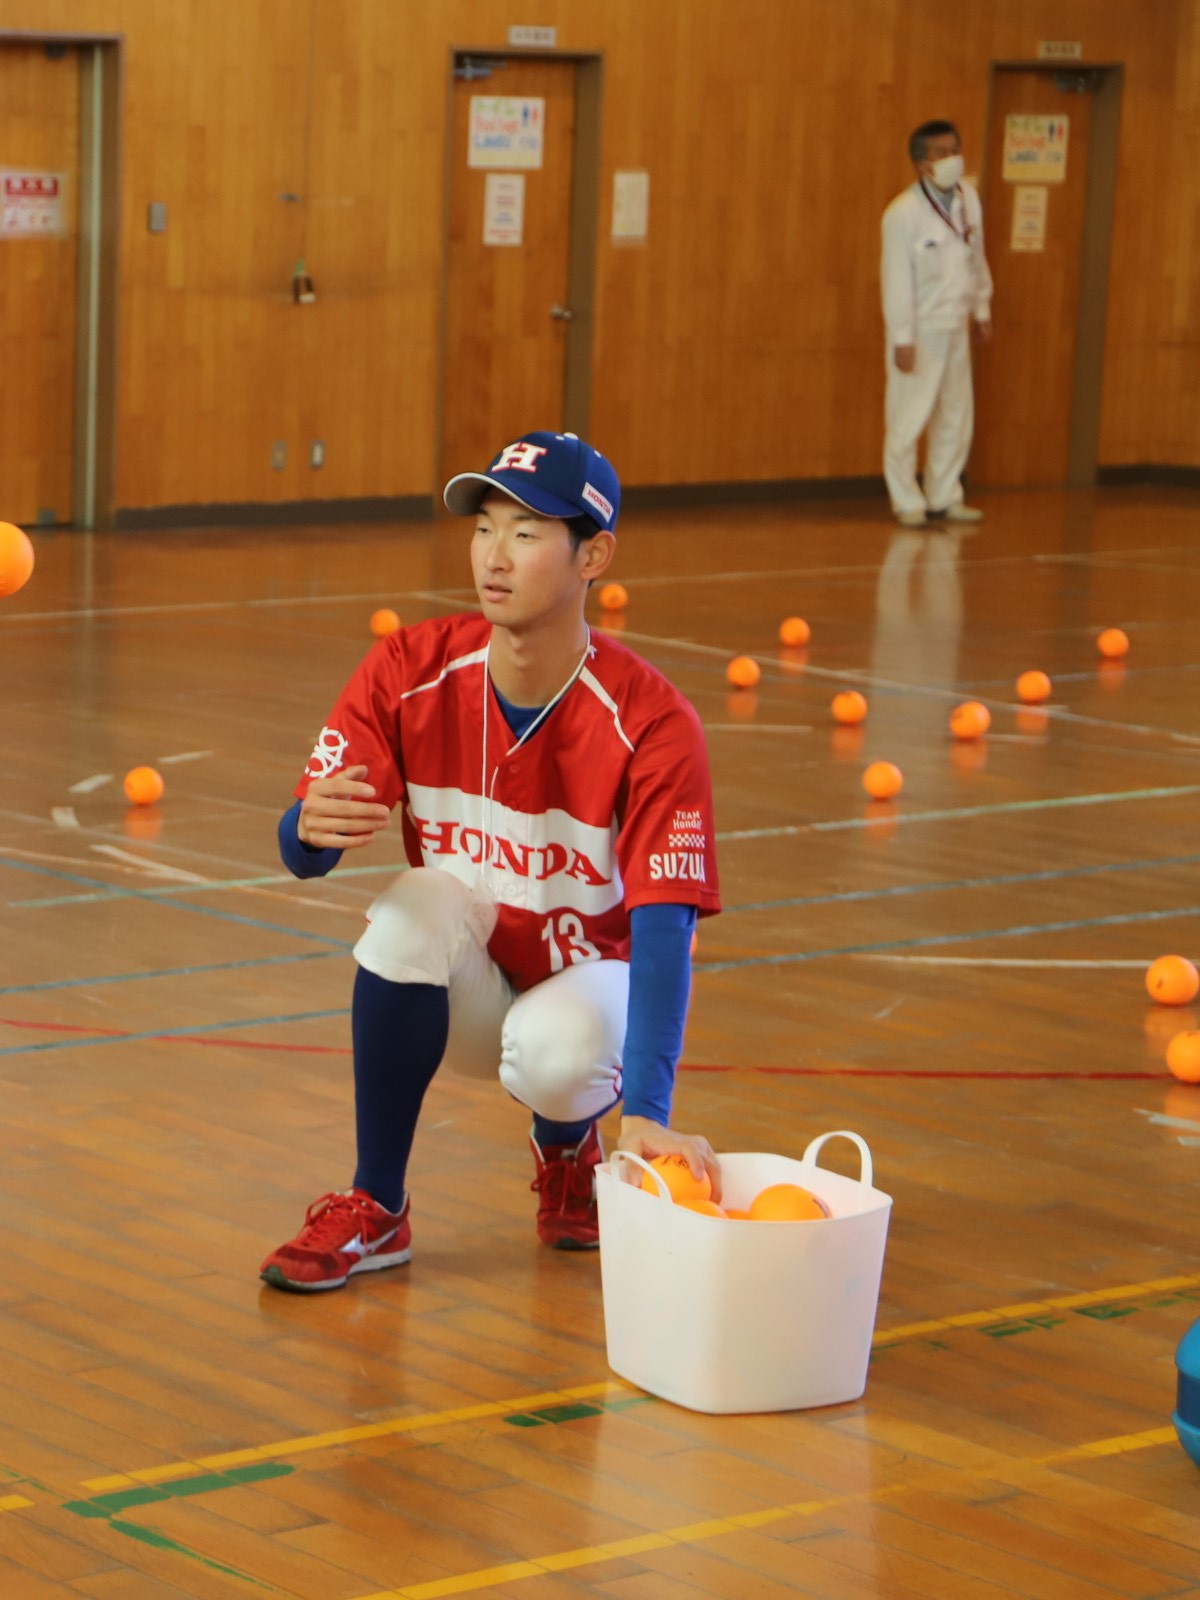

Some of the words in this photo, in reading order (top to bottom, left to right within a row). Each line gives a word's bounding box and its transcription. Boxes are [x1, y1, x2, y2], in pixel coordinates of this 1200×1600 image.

[491, 441, 547, 473] H
[588, 489, 611, 515] HONDA
[675, 810, 700, 820] TEAM
[415, 817, 612, 887] HONDA
[541, 912, 602, 973] 13
